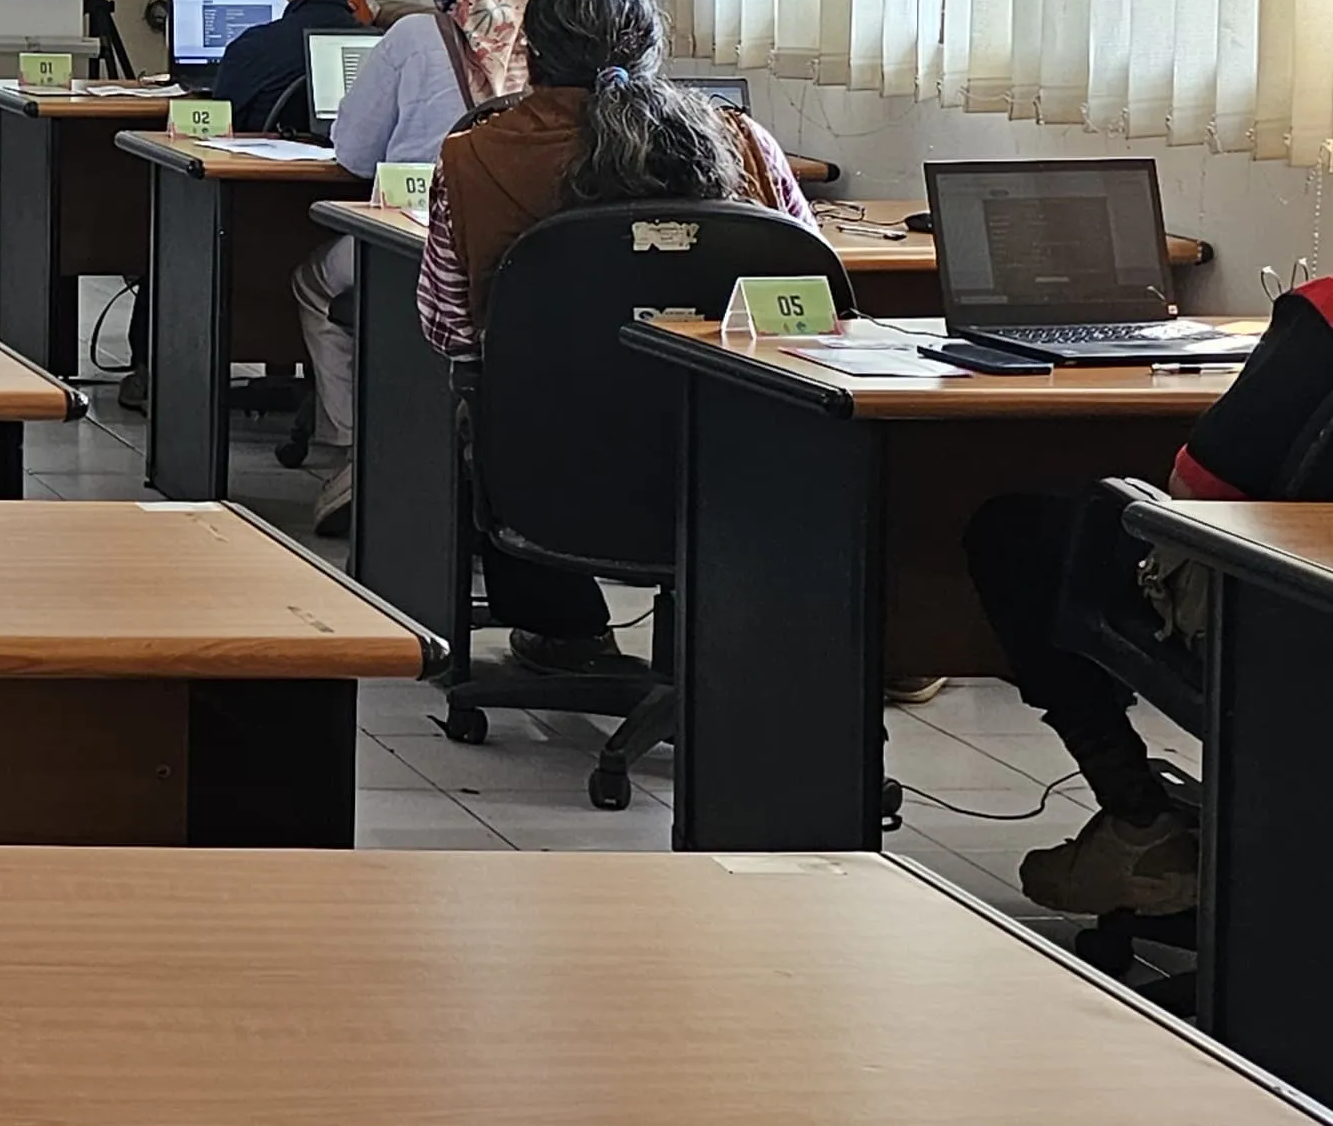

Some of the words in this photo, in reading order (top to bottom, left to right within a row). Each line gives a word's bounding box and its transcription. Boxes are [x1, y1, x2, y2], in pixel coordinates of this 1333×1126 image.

[39, 61, 52, 75] 01
[192, 111, 210, 125] 02
[406, 177, 426, 195] 03
[777, 294, 805, 317] 05
